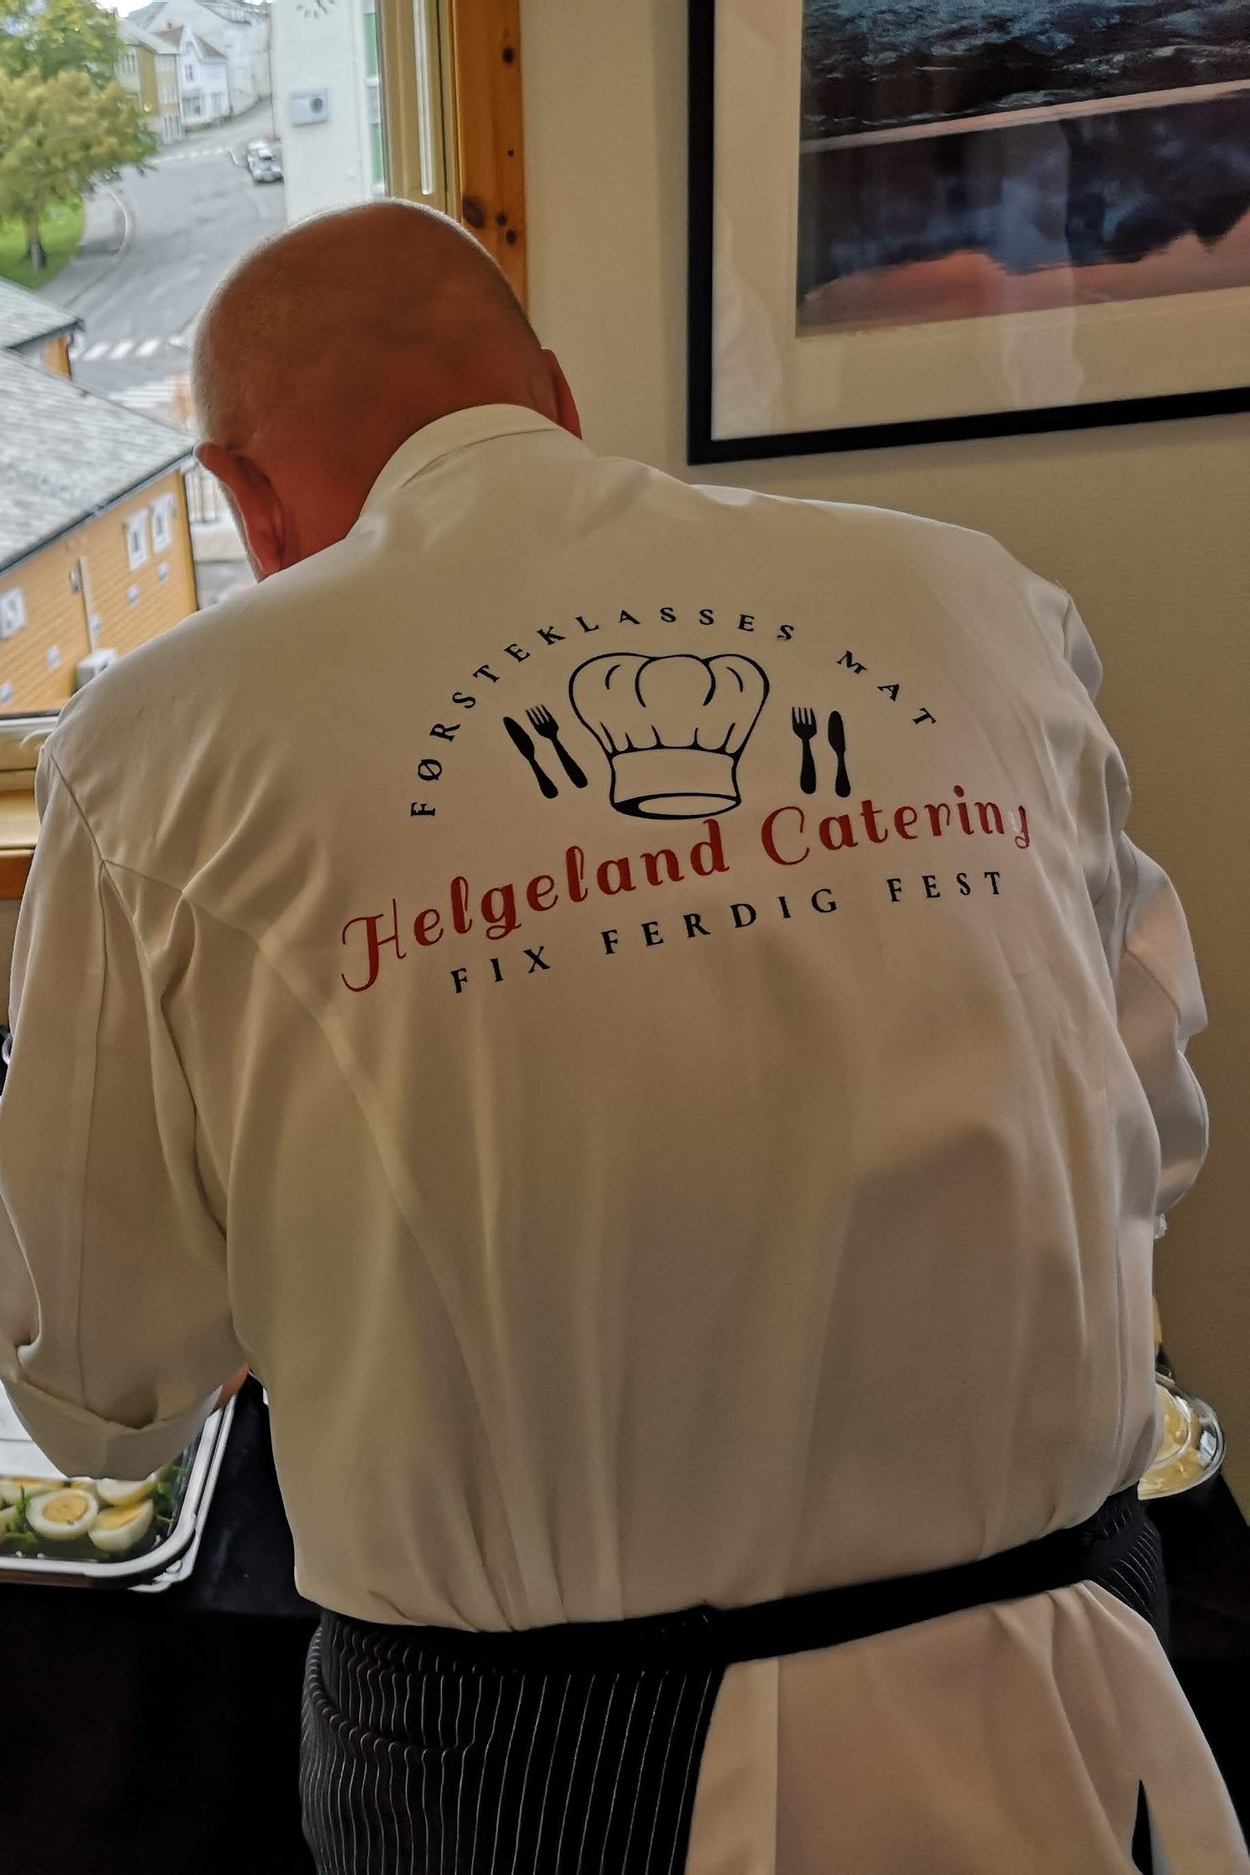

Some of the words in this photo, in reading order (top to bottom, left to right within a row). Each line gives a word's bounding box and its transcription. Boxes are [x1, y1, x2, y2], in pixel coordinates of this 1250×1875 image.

[410, 606, 796, 818] FØRSTEKLASSES
[837, 650, 937, 727] MAT
[341, 818, 730, 992] Helgeland
[452, 945, 551, 993] FIX
[601, 888, 838, 955] FERDIG
[888, 871, 1003, 903] FEST
